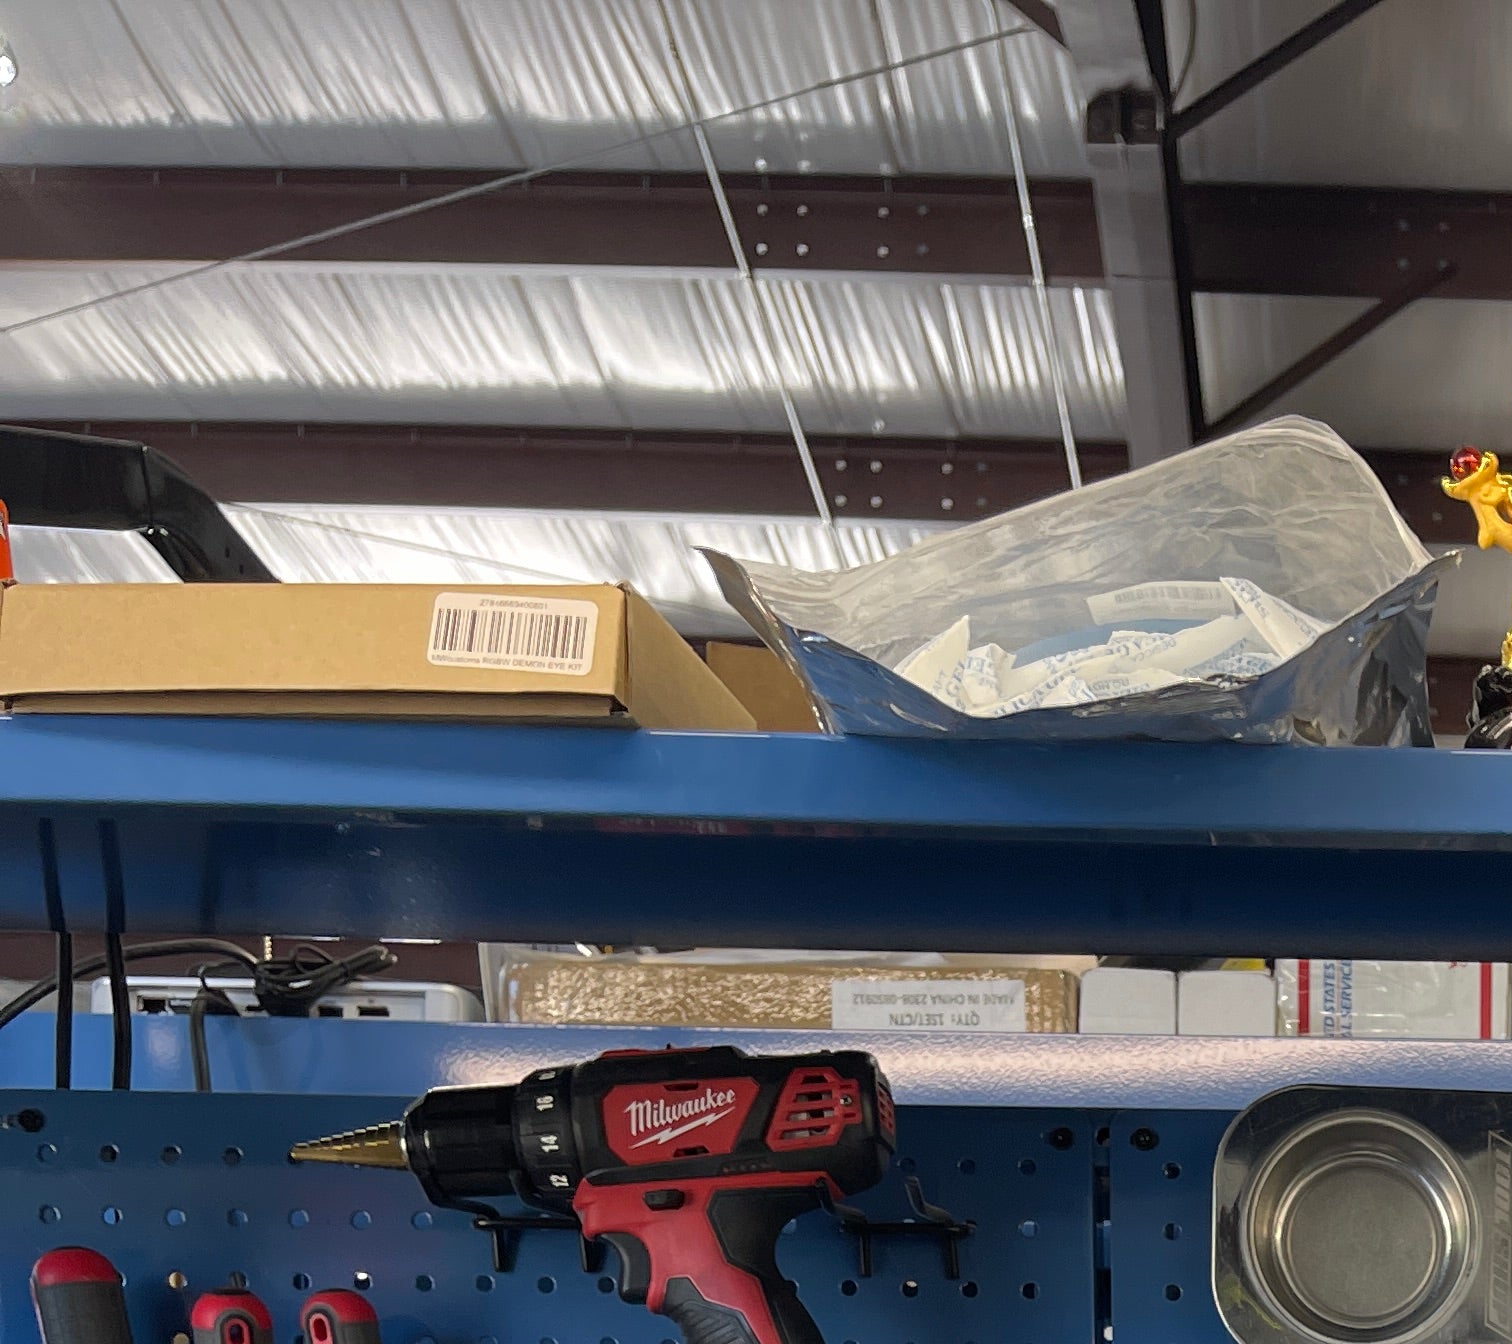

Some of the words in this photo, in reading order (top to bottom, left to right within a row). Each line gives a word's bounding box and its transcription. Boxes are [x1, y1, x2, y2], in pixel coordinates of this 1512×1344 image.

[512, 659, 546, 669] DEMON
[548, 661, 566, 671] EYE
[568, 663, 583, 672] KIT
[1323, 962, 1335, 1013] STATES
[930, 993, 966, 1005] CHINA
[624, 1088, 736, 1137] Milwaukee
[541, 1134, 560, 1153] 14
[550, 1173, 570, 1188] 12
